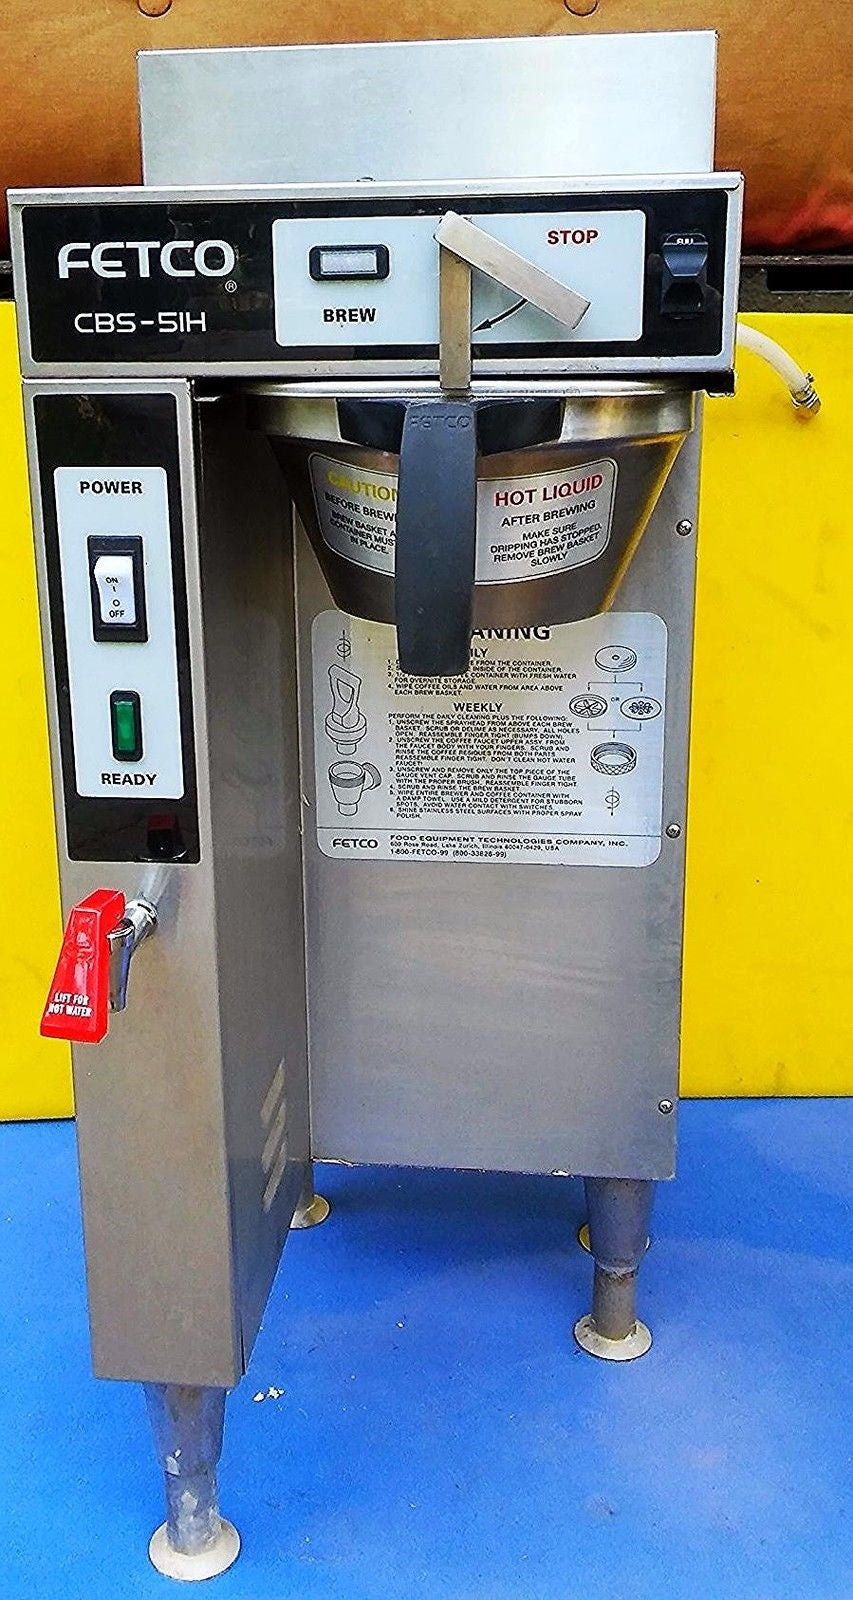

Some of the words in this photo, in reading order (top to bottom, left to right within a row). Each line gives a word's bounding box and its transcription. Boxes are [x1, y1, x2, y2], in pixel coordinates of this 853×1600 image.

[547, 230, 598, 245] STOP
[58, 240, 235, 278] FETCO
[323, 308, 376, 323] BREW
[80, 481, 142, 494] POWER
[495, 489, 536, 506] HOT
[542, 474, 603, 502] LIQUID
[325, 492, 360, 513] BEFORE
[501, 514, 540, 528] AFTER
[544, 500, 596, 522] BREWING
[330, 519, 372, 540] CONTAINER
[332, 510, 353, 525] BREW
[356, 520, 388, 536] BASKET
[522, 528, 550, 540] MAKE
[552, 522, 577, 536] SURE
[350, 536, 358, 544] IN
[490, 540, 538, 554] DRIPPING
[540, 536, 559, 547] HAS
[494, 549, 535, 562] REMOVE
[538, 543, 565, 556] BREW
[567, 532, 599, 548] BASKET
[530, 551, 568, 568] SLOWLY
[454, 702, 504, 712] WEEKLY
[101, 773, 158, 786] READY
[332, 838, 378, 848] FETCO
[54, 992, 72, 1003] LIFT
[73, 994, 89, 1005] FOR
[48, 1003, 65, 1014] HOT
[66, 1005, 92, 1016] WATER
